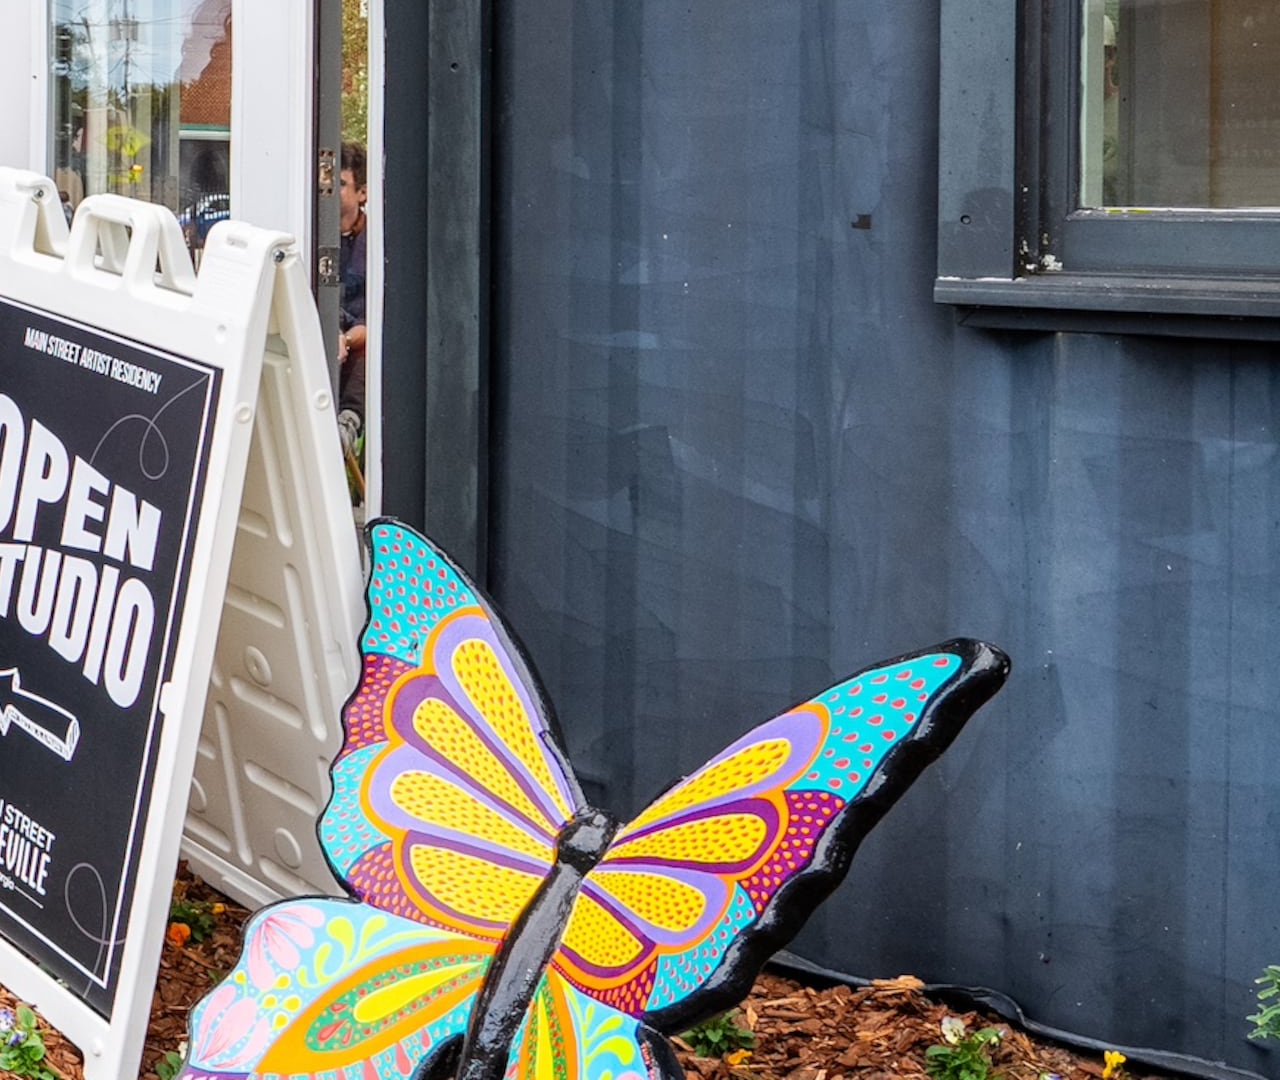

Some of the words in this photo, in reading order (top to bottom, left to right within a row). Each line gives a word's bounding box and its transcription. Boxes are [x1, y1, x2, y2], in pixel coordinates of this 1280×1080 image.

[23, 326, 50, 353] MAIN
[47, 335, 82, 365] STREET
[79, 347, 112, 377] ARTIST
[110, 358, 163, 395] RESIDENCY
[4, 804, 56, 852] STREET
